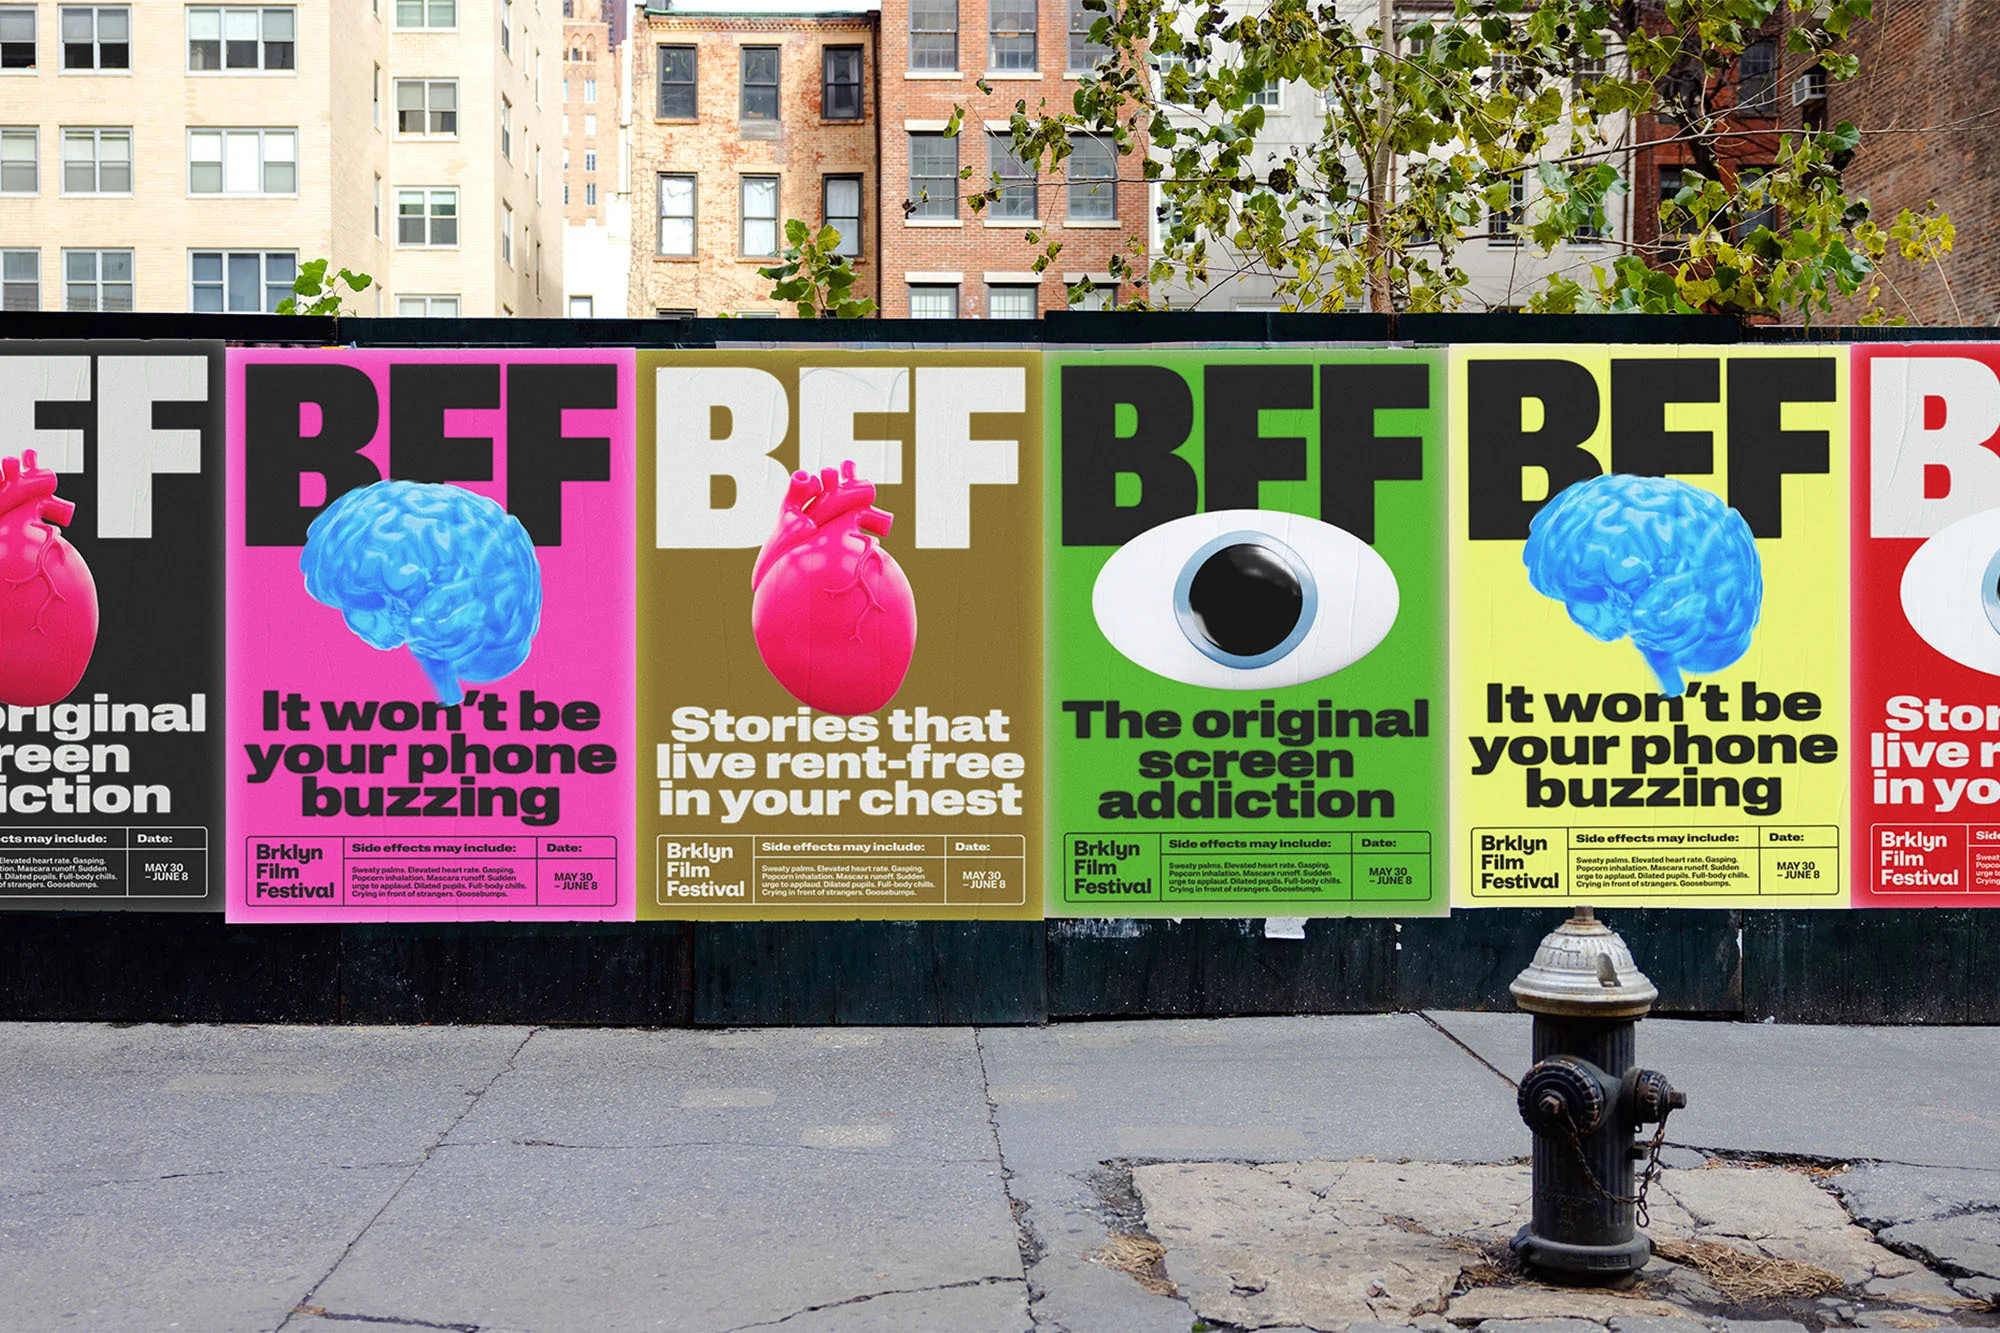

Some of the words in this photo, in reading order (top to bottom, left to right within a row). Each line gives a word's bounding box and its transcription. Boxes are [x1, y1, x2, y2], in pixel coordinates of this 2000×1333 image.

[245, 363, 617, 546] BFF
[1061, 363, 1430, 546] BFF
[1467, 357, 1837, 540] BFF
[656, 366, 1026, 549] BFF
[1487, 683, 1534, 723] It
[1544, 682, 1729, 723] won't
[1741, 681, 1821, 722] be
[0, 693, 206, 741] riginal
[263, 690, 310, 731] It
[320, 690, 507, 731] won't
[520, 690, 601, 731] be
[671, 706, 880, 742] Stories
[888, 708, 1010, 742] that
[1061, 700, 1182, 739] The
[1192, 699, 1429, 747] original
[1468, 735, 1619, 775] your
[1632, 724, 1838, 774] phone
[1871, 732, 1970, 768] live
[244, 743, 397, 783] your
[408, 733, 617, 783] phone
[656, 743, 756, 779] live
[766, 743, 1025, 779] rent-free
[1138, 749, 1354, 779] screen
[1526, 767, 1782, 816] buzzing
[1873, 769, 1924, 804] in
[301, 776, 560, 827] buzzing
[659, 780, 711, 816] in
[719, 788, 851, 824] your
[859, 780, 1023, 816] chest
[1098, 780, 1395, 819] addiction
[24, 836, 52, 844] may
[55, 834, 107, 843] include:
[137, 834, 173, 843] Date:
[1169, 840, 1197, 848] Side
[1200, 839, 1247, 848] effects
[1250, 841, 1277, 849] may
[1280, 839, 1331, 848] include:
[1361, 838, 1397, 847] Date:
[1481, 835, 1547, 855] Brklyn
[1576, 834, 1605, 842] Side
[1607, 834, 1655, 842] effects
[1657, 835, 1685, 844] may
[1687, 834, 1739, 842] include:
[1769, 833, 1804, 842] Date:
[1881, 831, 1947, 852] Brklyn
[256, 844, 323, 864] Brklyn
[352, 843, 381, 852] Side
[383, 844, 431, 852] effects
[434, 845, 461, 854] may
[464, 844, 516, 852] include:
[547, 843, 582, 852] Date:
[667, 843, 733, 863] Brklyn
[762, 842, 791, 851] Side
[793, 842, 840, 851] effects
[843, 844, 870, 852] may
[873, 843, 925, 851] include:
[955, 842, 990, 851] Date:
[1074, 840, 1140, 861] Brklyn
[73, 857, 106, 865] Gasping.
[1482, 854, 1524, 870] Film
[1777, 861, 1800, 870] MAY
[1802, 861, 1816, 870] 30
[1881, 850, 1924, 866] Film
[145, 863, 168, 872] MAY
[170, 863, 184, 872] 30
[256, 863, 299, 879] Film
[667, 861, 710, 878] Film
[891, 865, 924, 873] Gasping.
[1074, 859, 1117, 875] Film
[1369, 867, 1392, 876] MAY
[1394, 867, 1408, 876] 30
[1784, 870, 1811, 879] JUNE
[1813, 870, 1820, 879] 8
[153, 872, 180, 881] JUNE
[181, 872, 188, 881] 8
[554, 872, 578, 881] MAY
[579, 872, 593, 881] 30
[963, 871, 986, 880] MAY
[987, 871, 1001, 880] 30
[1377, 876, 1404, 885] JUNE
[1405, 876, 1412, 885] 8
[1482, 872, 1559, 889] Festival
[1881, 869, 1958, 885] Festival
[47, 881, 99, 889] Goosebumps.
[256, 882, 334, 898] Festival
[562, 881, 589, 890] JUNE
[591, 881, 598, 890] 8
[667, 880, 745, 897] Festival
[970, 880, 997, 889] JUNE
[999, 880, 1006, 889] 8
[1074, 878, 1152, 894] Festival
